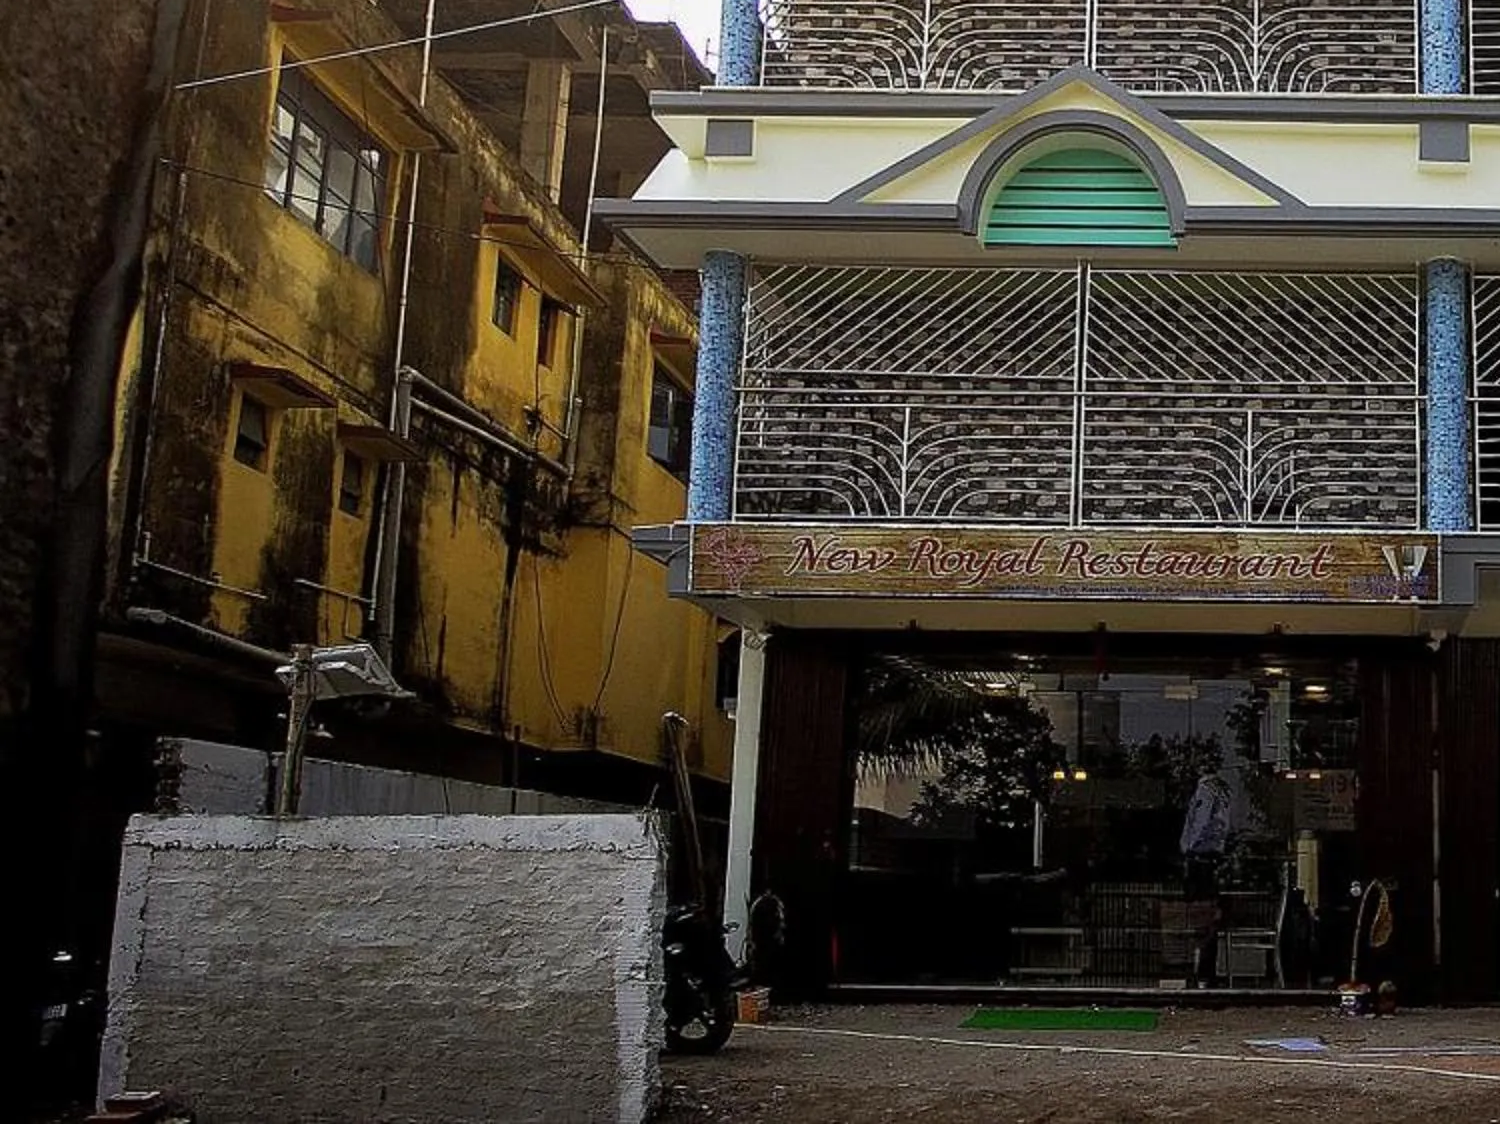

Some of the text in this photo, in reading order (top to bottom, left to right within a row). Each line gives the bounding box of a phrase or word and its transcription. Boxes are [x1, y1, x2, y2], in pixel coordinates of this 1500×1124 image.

[784, 534, 1337, 588] New Royal Restaurant
